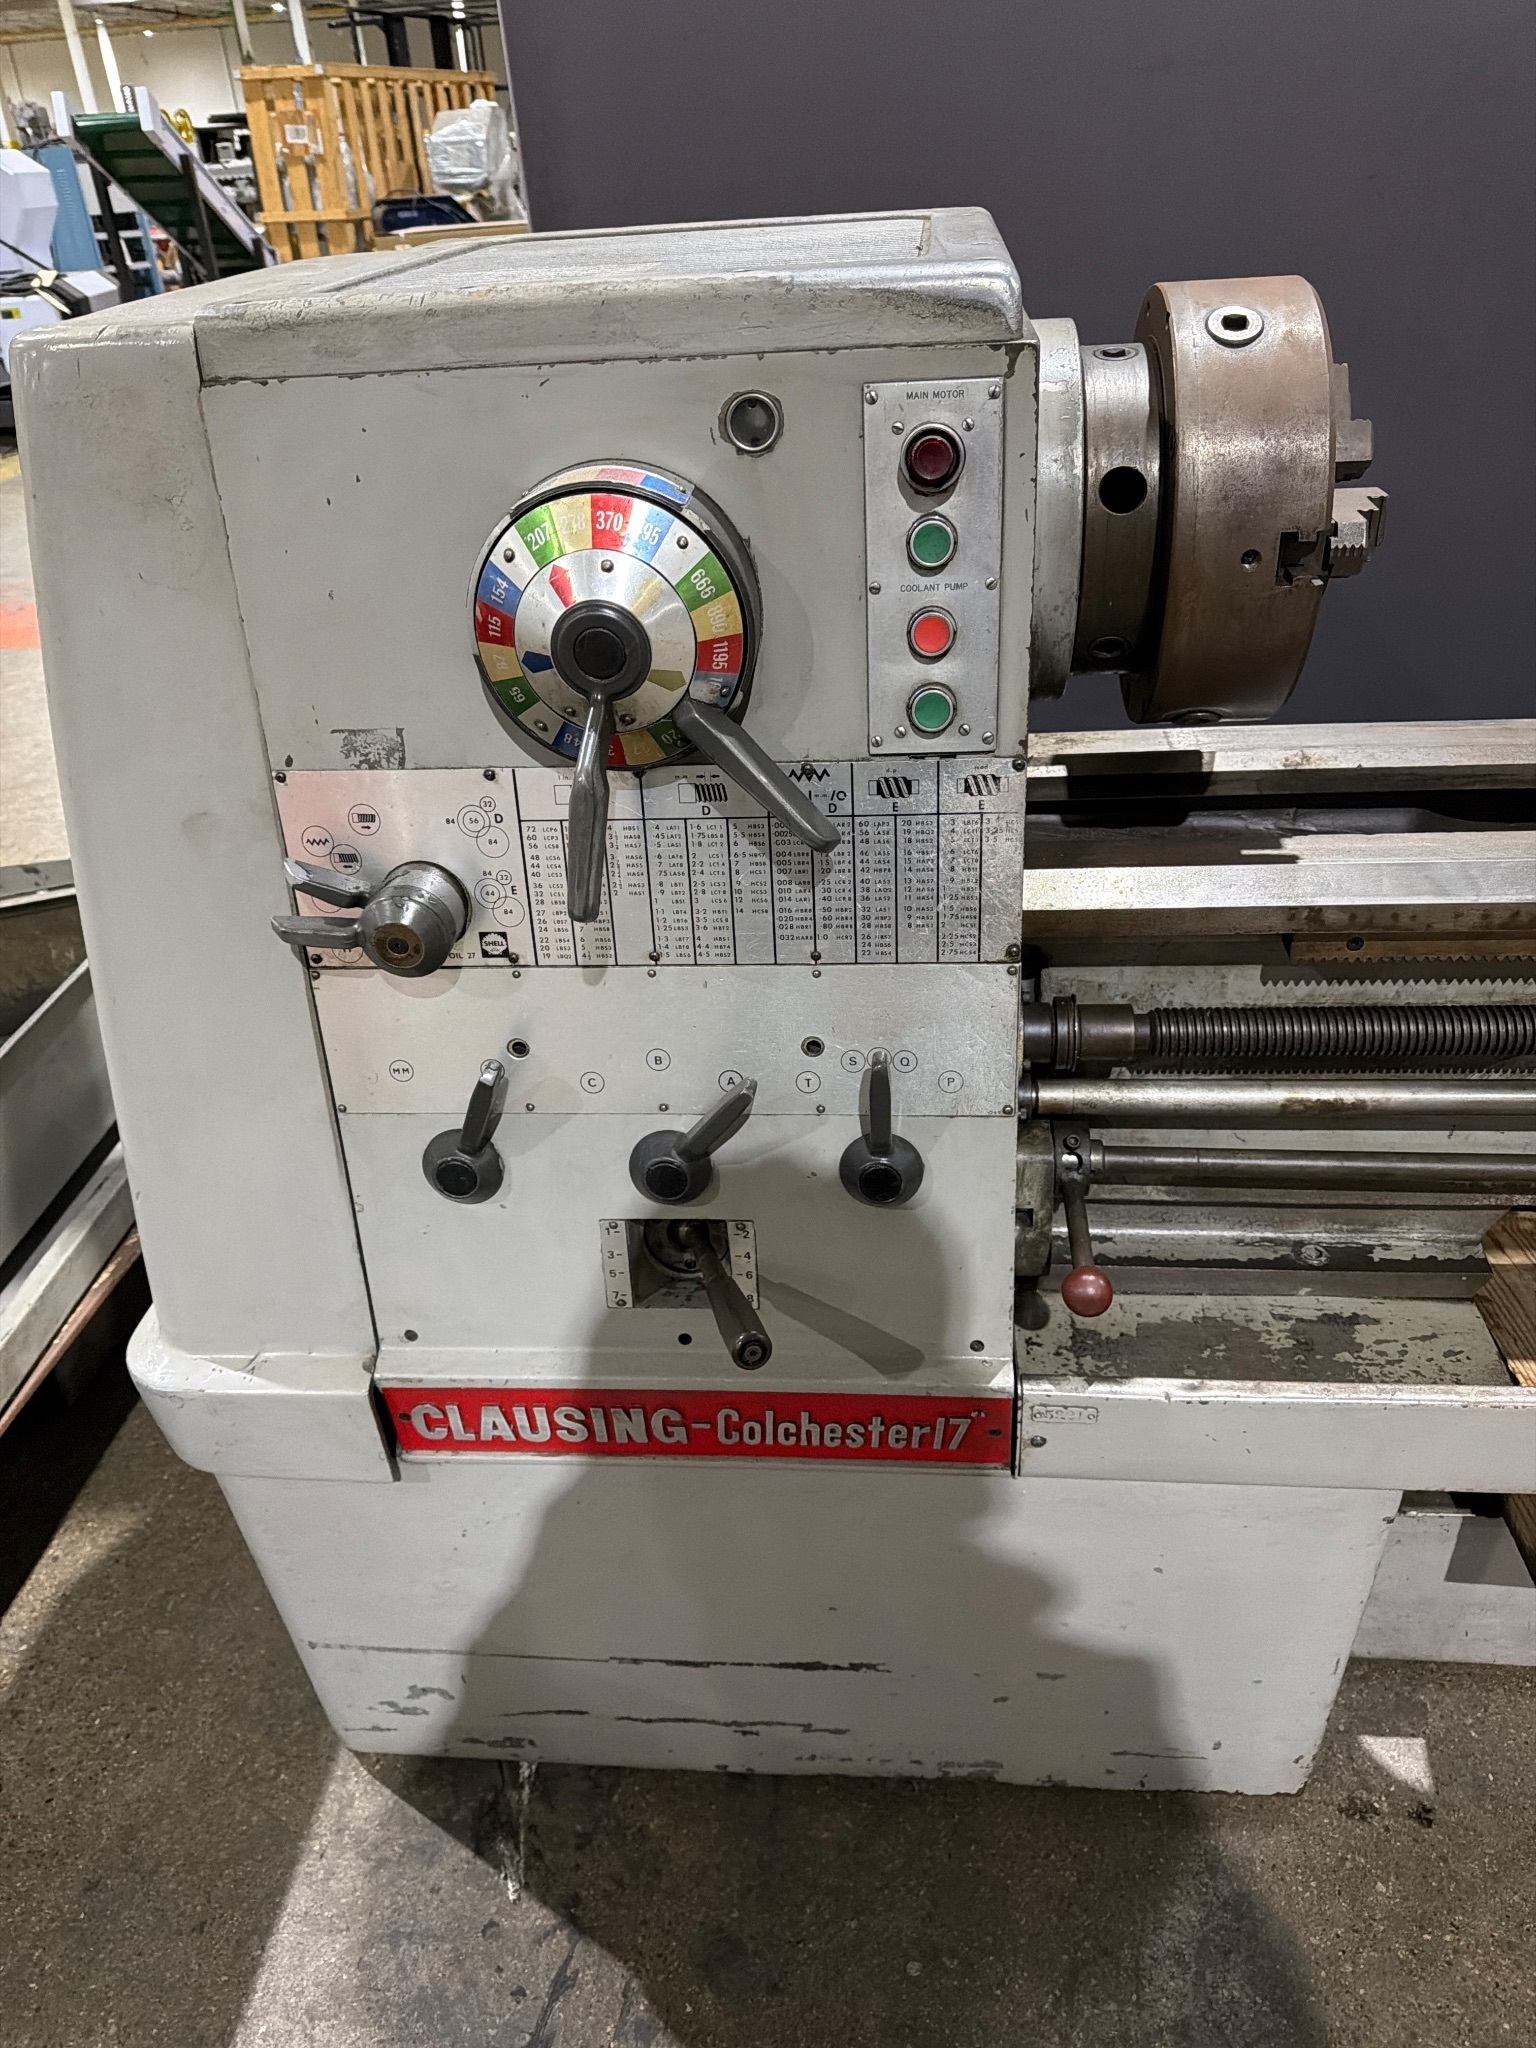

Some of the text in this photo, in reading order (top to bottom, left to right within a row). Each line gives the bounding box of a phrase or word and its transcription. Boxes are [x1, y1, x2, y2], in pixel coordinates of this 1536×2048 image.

[907, 390, 964, 400] MAIN MOTOR
[561, 513, 585, 534] 278
[596, 511, 623, 531] 370
[528, 523, 551, 550] 207
[642, 523, 662, 545] 95
[691, 569, 715, 598] 666
[901, 583, 968, 592] COOLANT PUMP
[491, 577, 509, 604] 154
[707, 605, 728, 633] 890
[488, 615, 501, 636] 115
[712, 641, 728, 669] 1195
[509, 686, 525, 702] 65
[828, 803, 838, 813] D
[892, 802, 899, 812] E
[978, 800, 985, 810] E
[702, 805, 711, 816] D
[494, 814, 503, 823] D
[655, 1056, 662, 1064] B
[850, 1057, 856, 1066] S
[900, 1057, 910, 1066] Q
[588, 1078, 596, 1087] C
[727, 1077, 735, 1086] A
[805, 1079, 812, 1088] T
[948, 1078, 954, 1086] P
[743, 1230, 750, 1238] 2
[744, 1252, 751, 1260] 4
[746, 1271, 753, 1279] 6
[612, 1291, 619, 1299] 7
